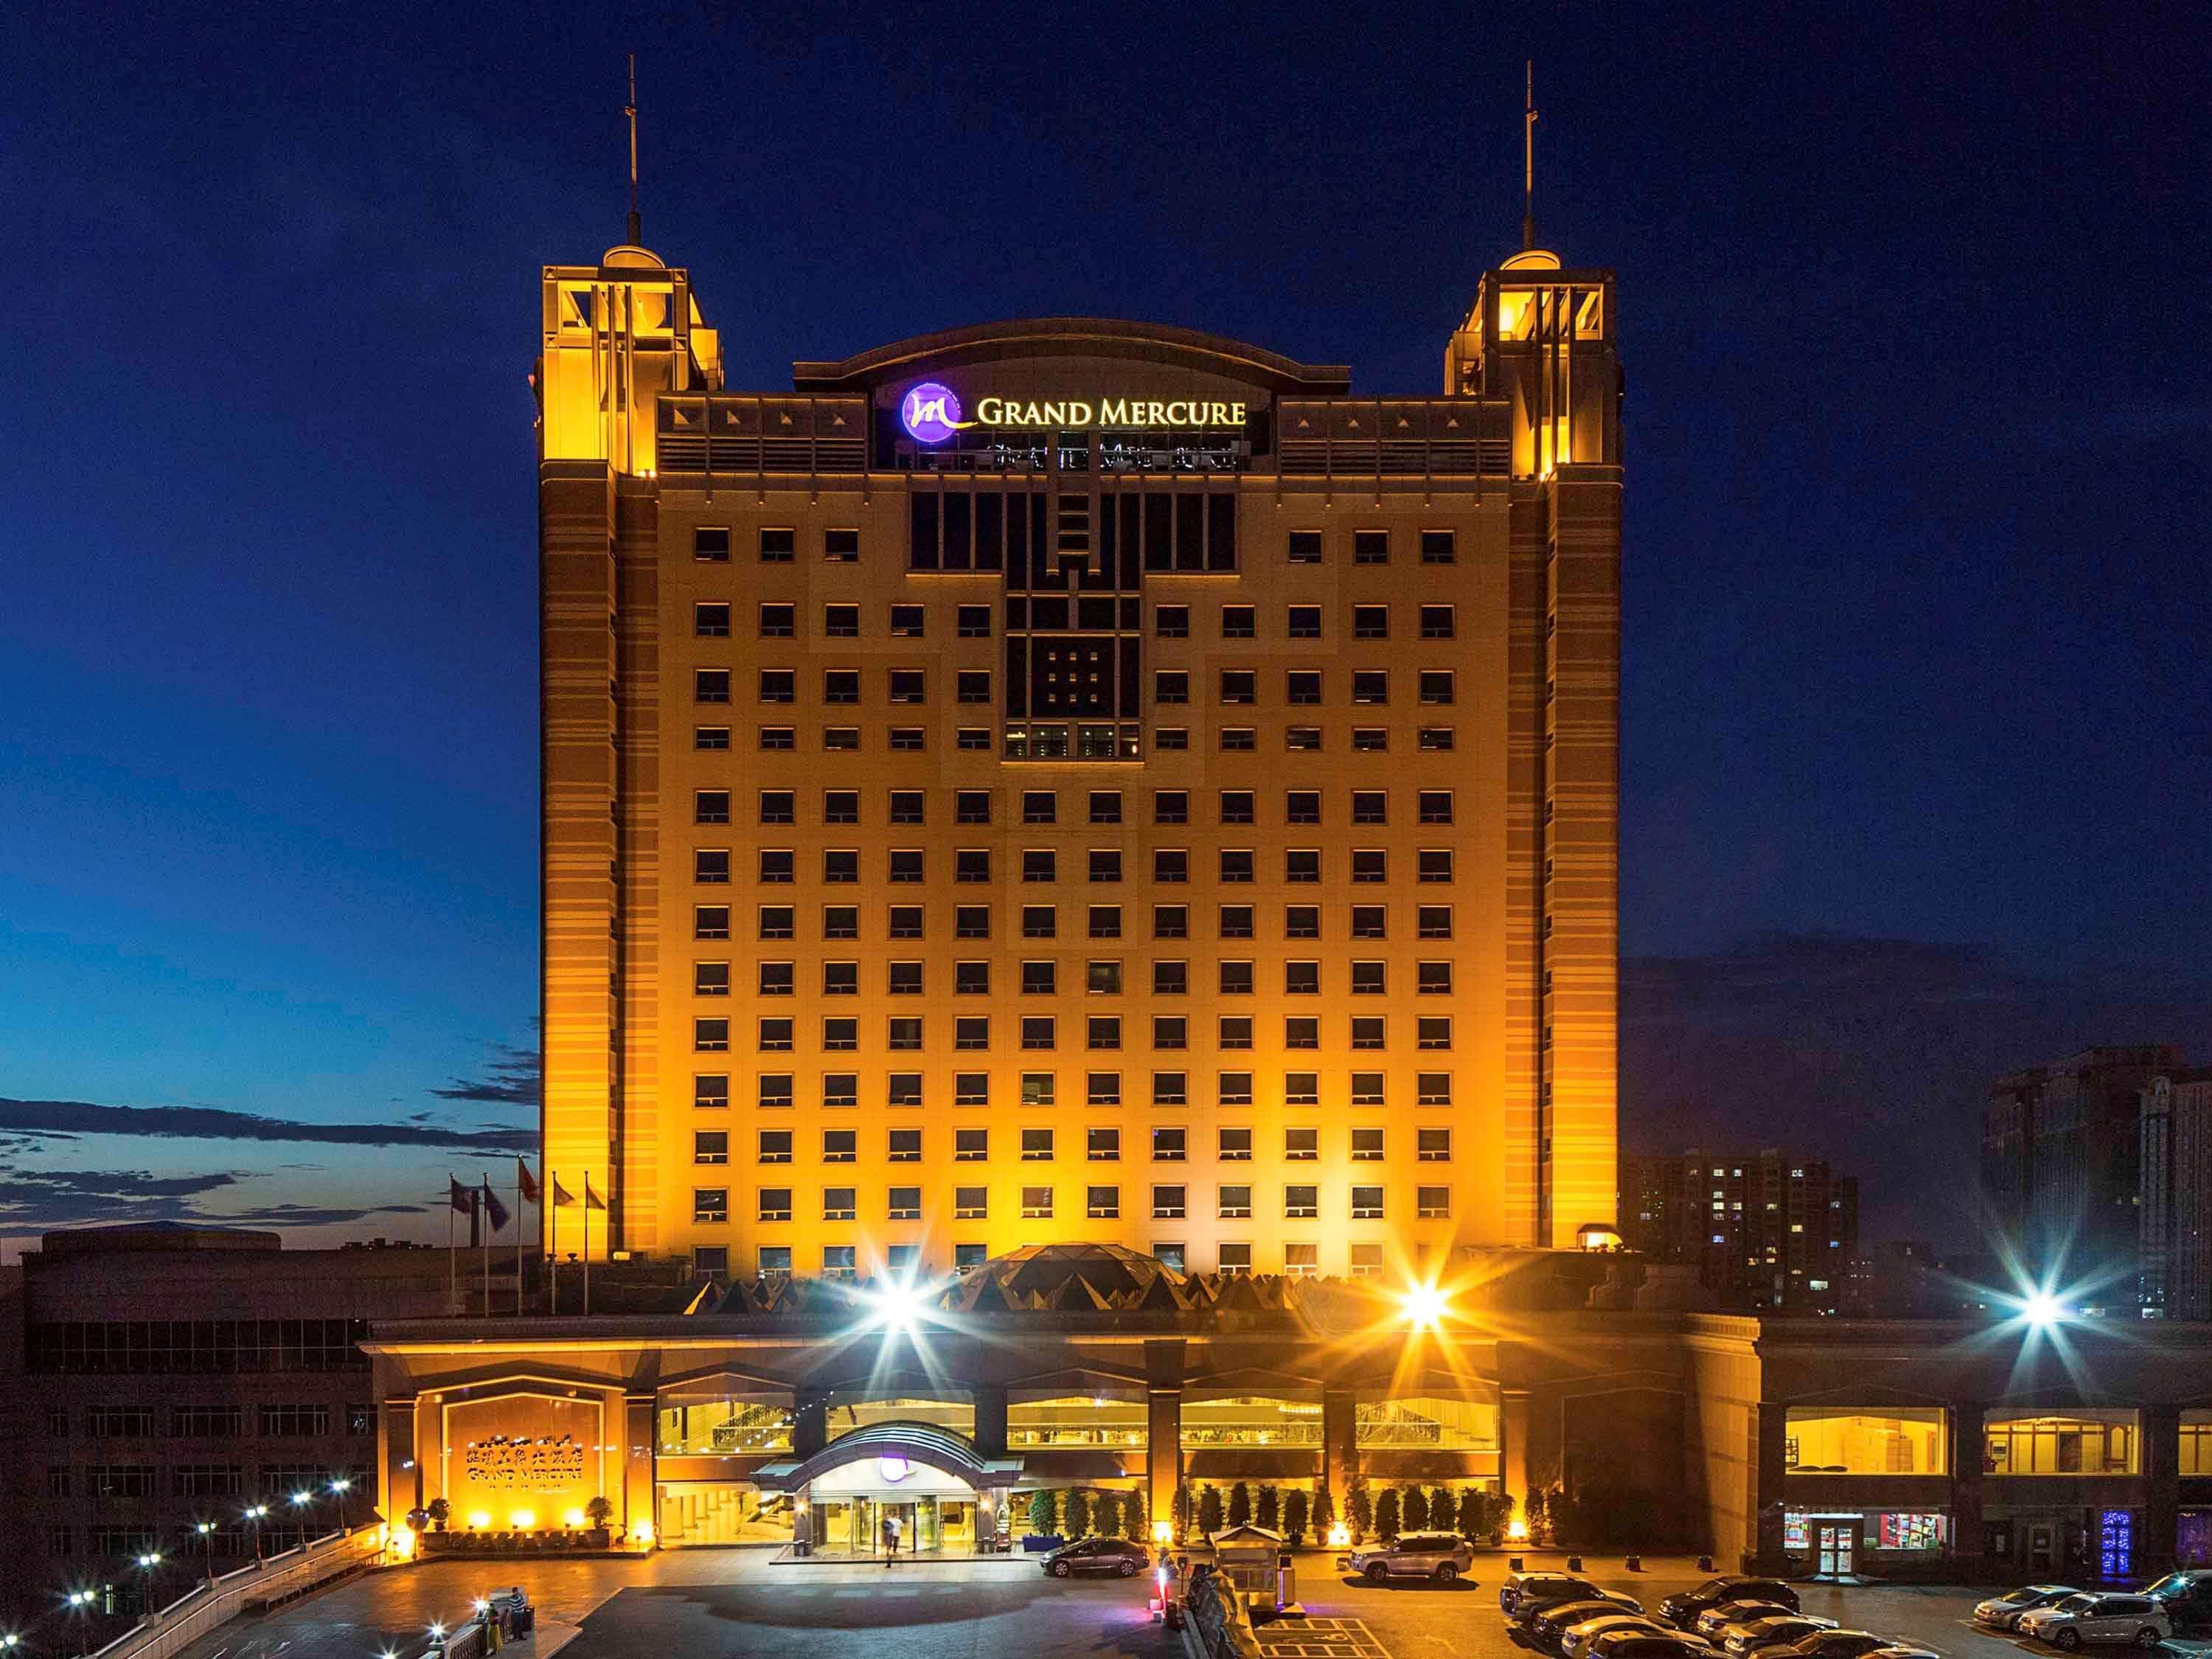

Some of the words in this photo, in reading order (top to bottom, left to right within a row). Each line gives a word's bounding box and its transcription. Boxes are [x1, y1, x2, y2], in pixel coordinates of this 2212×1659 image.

[978, 397, 1092, 425] GRAND
[1099, 398, 1246, 425] MERCURE
[467, 1467, 515, 1481] GRAND
